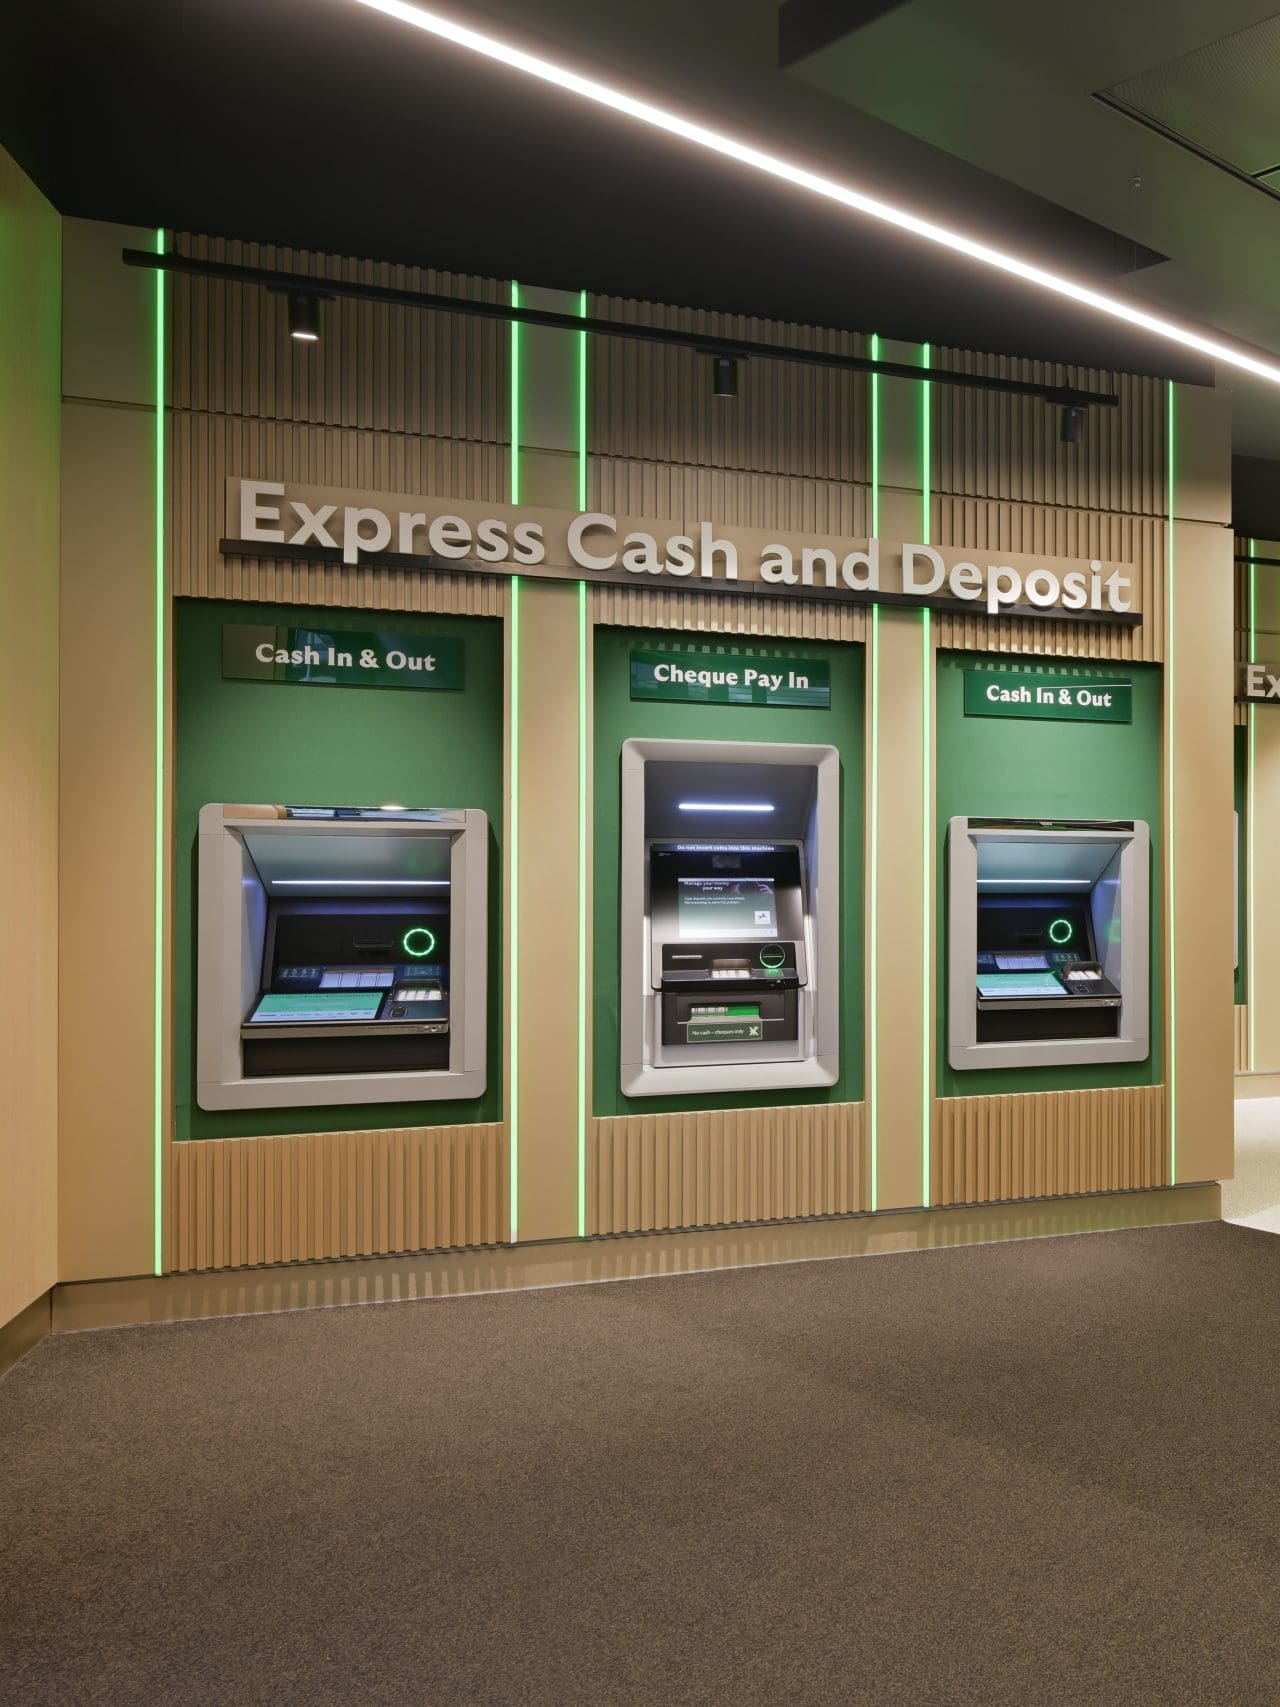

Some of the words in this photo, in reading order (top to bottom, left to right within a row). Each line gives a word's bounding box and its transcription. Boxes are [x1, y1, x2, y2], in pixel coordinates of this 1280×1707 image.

[240, 480, 545, 564] Express
[567, 513, 738, 580] Cash
[760, 538, 879, 591] and
[902, 543, 1131, 614] Deposit
[255, 643, 320, 666] Cash
[328, 647, 353, 667] In
[359, 649, 380, 669] &
[386, 650, 436, 671] Out
[653, 664, 738, 687] Cheque
[744, 669, 783, 691] Pay
[789, 671, 809, 689] In
[986, 685, 1032, 703] Cash
[1036, 687, 1054, 704] In
[1058, 689, 1072, 705] &
[1076, 690, 1112, 707] Out
